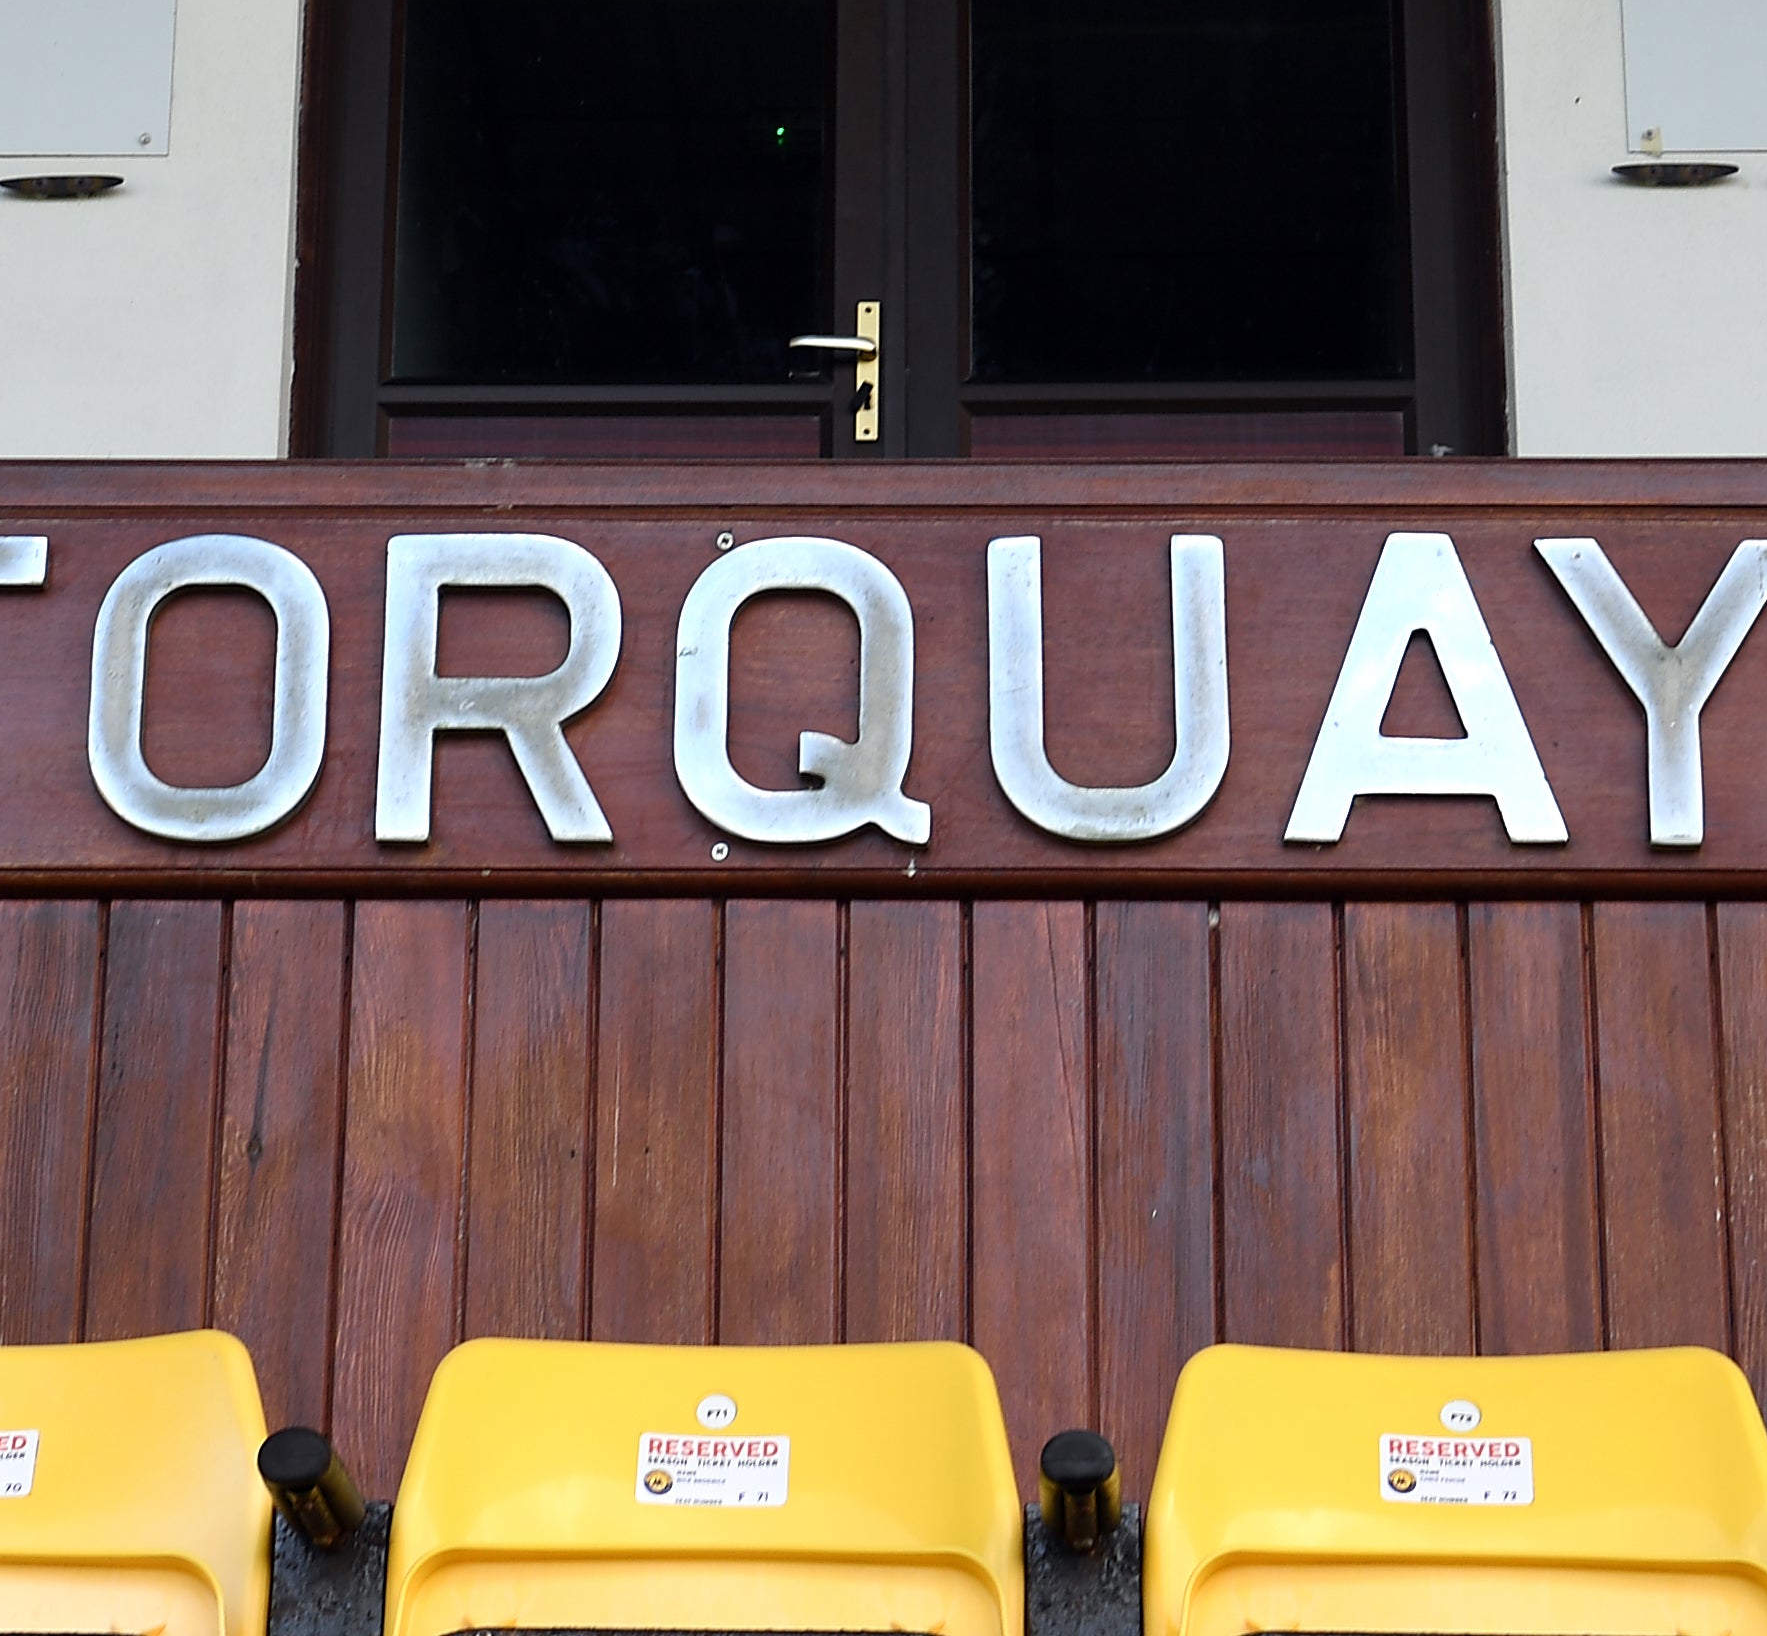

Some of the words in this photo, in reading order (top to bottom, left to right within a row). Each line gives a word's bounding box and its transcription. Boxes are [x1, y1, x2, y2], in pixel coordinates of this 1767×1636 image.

[707, 1408, 727, 1418] F71
[648, 1437, 778, 1458] RESERVED
[1389, 1439, 1520, 1458] RESERVED
[648, 1456, 687, 1466] SEASON
[697, 1459, 731, 1467] TICKET
[1389, 1456, 1429, 1466] SEASON
[1439, 1459, 1473, 1467] TICKET
[5, 1483, 22, 1493] 70
[757, 1492, 769, 1502] 71
